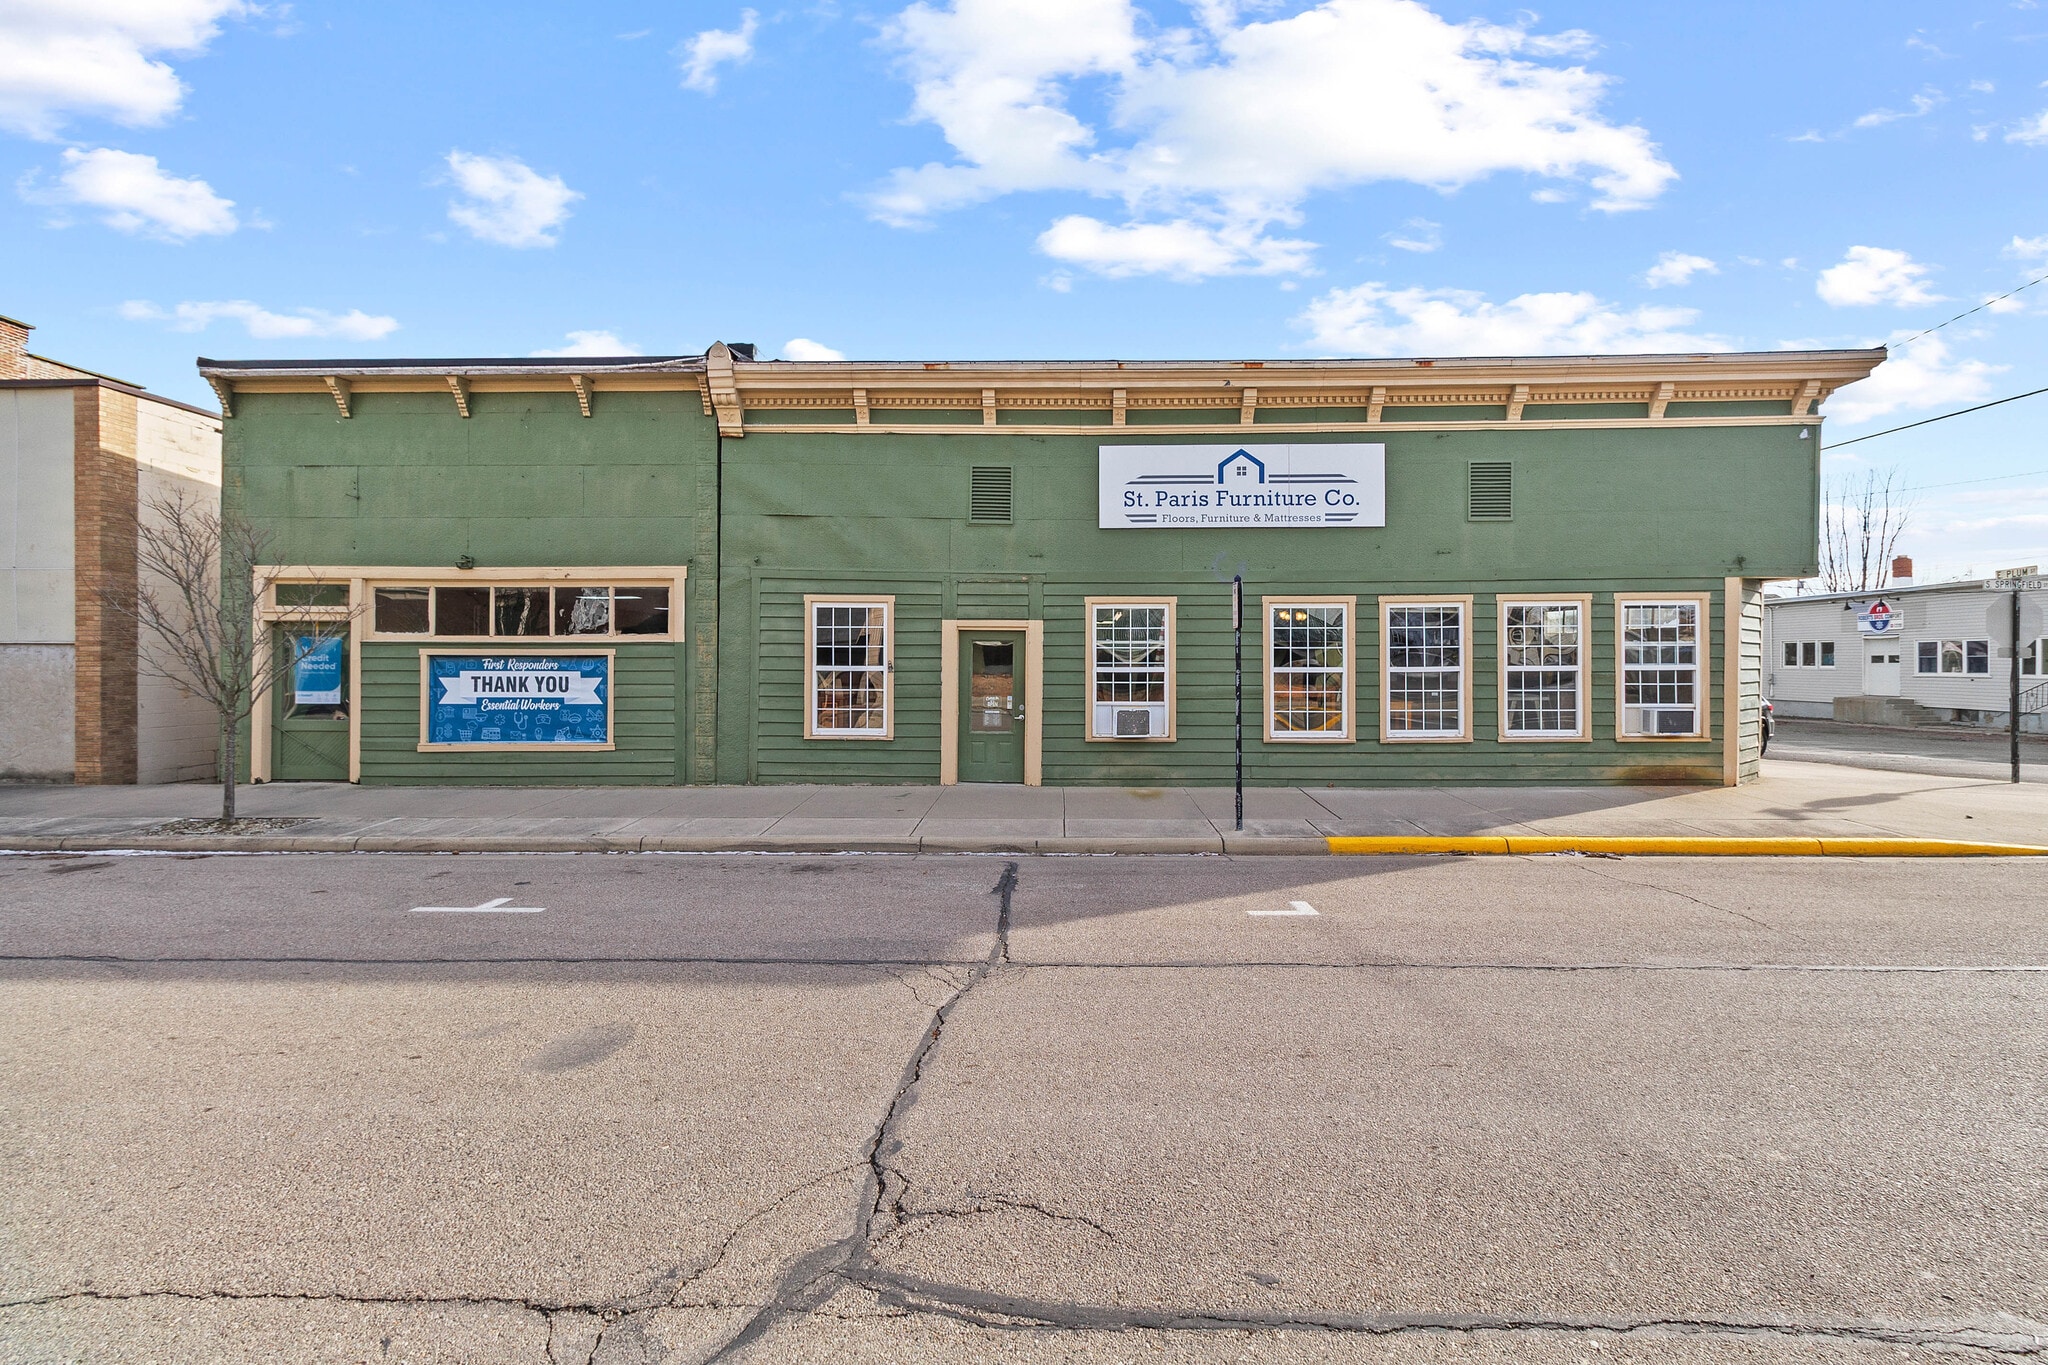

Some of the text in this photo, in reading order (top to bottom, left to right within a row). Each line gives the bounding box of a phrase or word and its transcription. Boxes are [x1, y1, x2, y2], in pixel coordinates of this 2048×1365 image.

[1124, 489, 1360, 507] St. Paris Furniture Co.
[1162, 514, 1321, 524] Floors, Furniture & Mattresses
[1997, 571, 2002, 579] E
[2006, 568, 2028, 578] PLUM
[1995, 580, 2042, 589] SPRINGFIELD
[301, 662, 335, 670] Needed
[482, 658, 559, 671] First Responders
[471, 676, 570, 693] THANK YOU
[481, 699, 560, 711] Essential Workers
